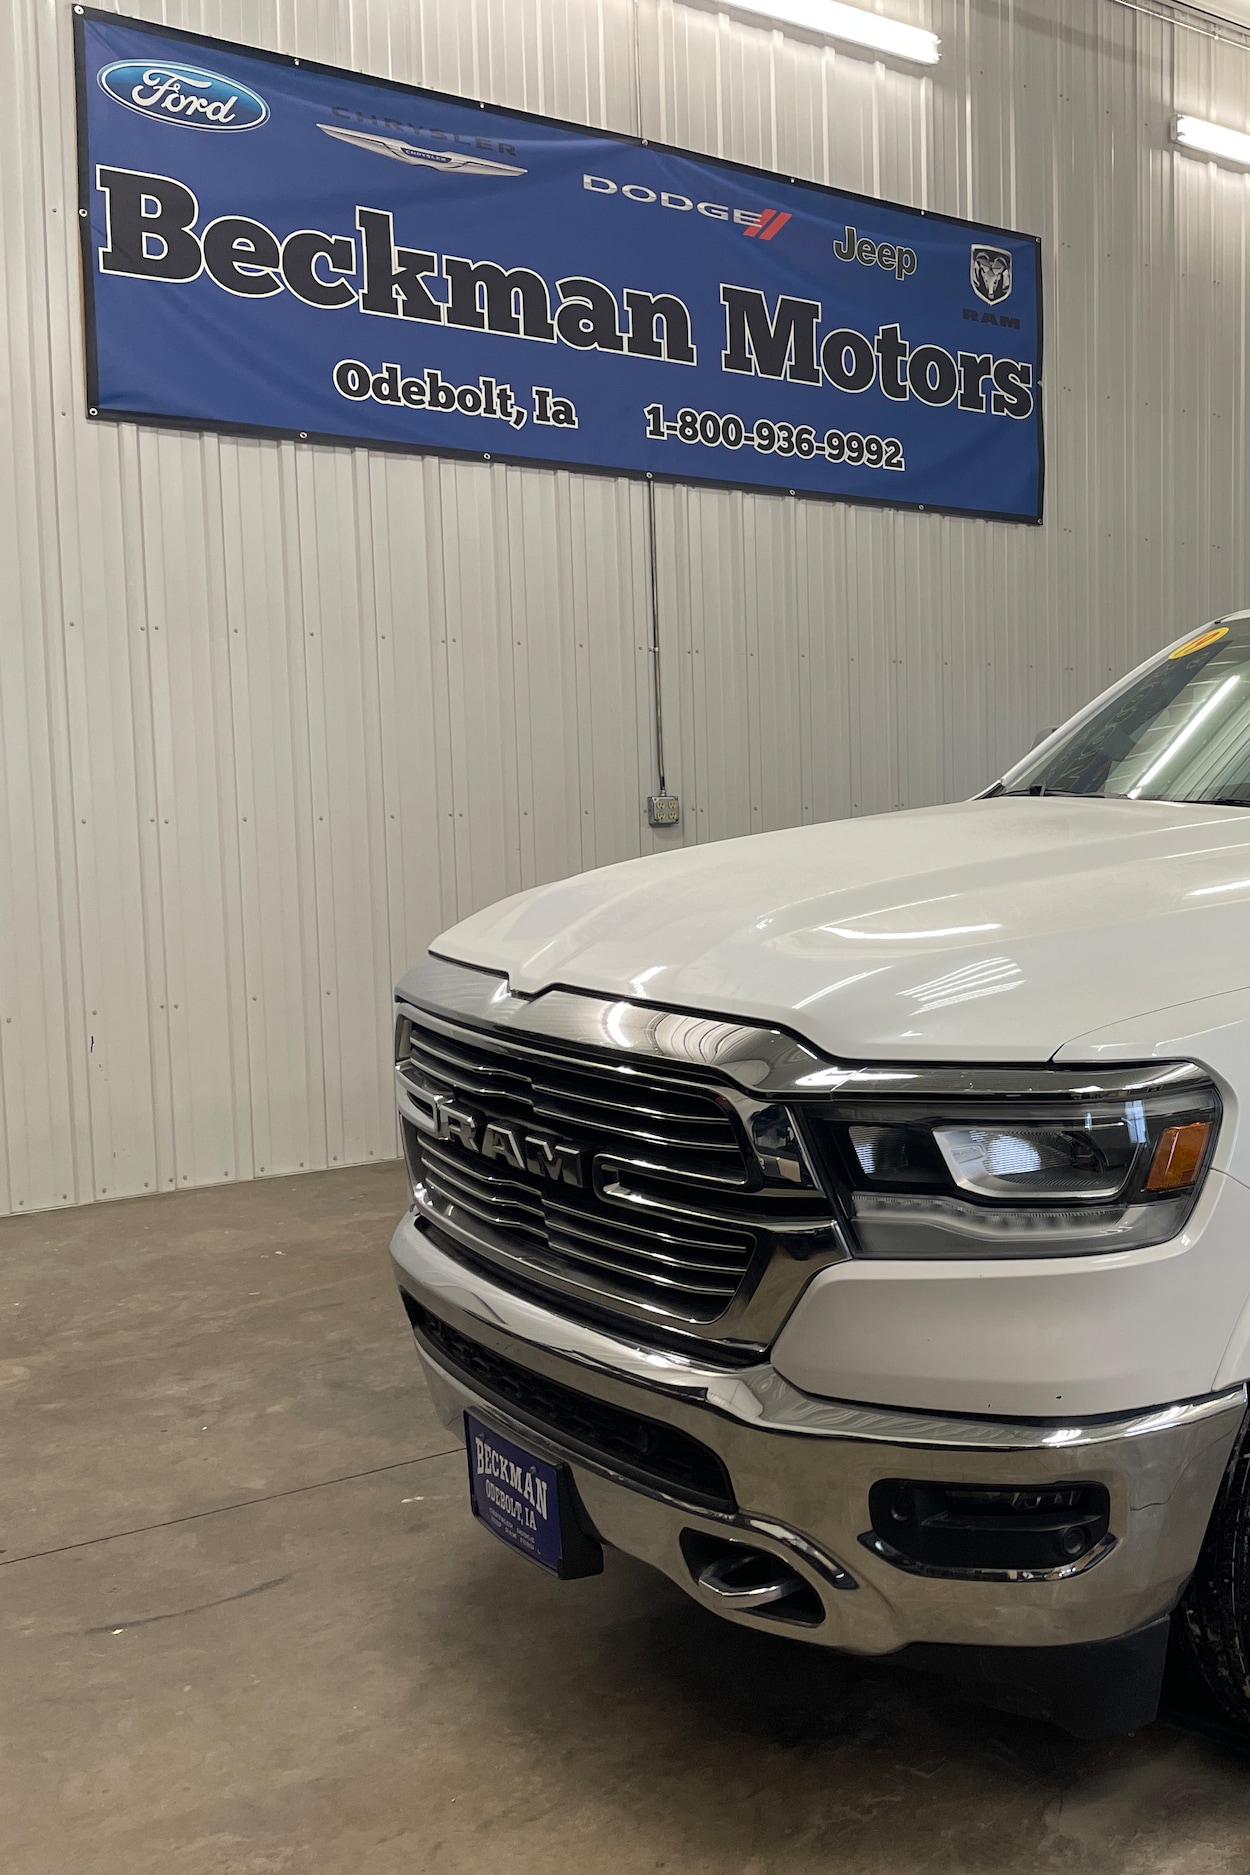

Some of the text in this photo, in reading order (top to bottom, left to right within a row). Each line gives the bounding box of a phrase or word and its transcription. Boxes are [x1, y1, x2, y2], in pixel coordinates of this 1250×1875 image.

[131, 69, 238, 124] Ford
[331, 106, 516, 157] CHRYSLER
[583, 174, 763, 228] DODGE
[833, 226, 918, 280] Jeep
[96, 164, 1033, 419] Beckman Motors
[962, 308, 1021, 330] RAM
[333, 359, 579, 429] Odebolt, Ia
[644, 403, 905, 471] 1-800-936-9992
[438, 1103, 584, 1189] RAM
[475, 1437, 548, 1521] BECKMAN
[485, 1479, 524, 1525] ODEBOLT,
[525, 1508, 537, 1531] IA
